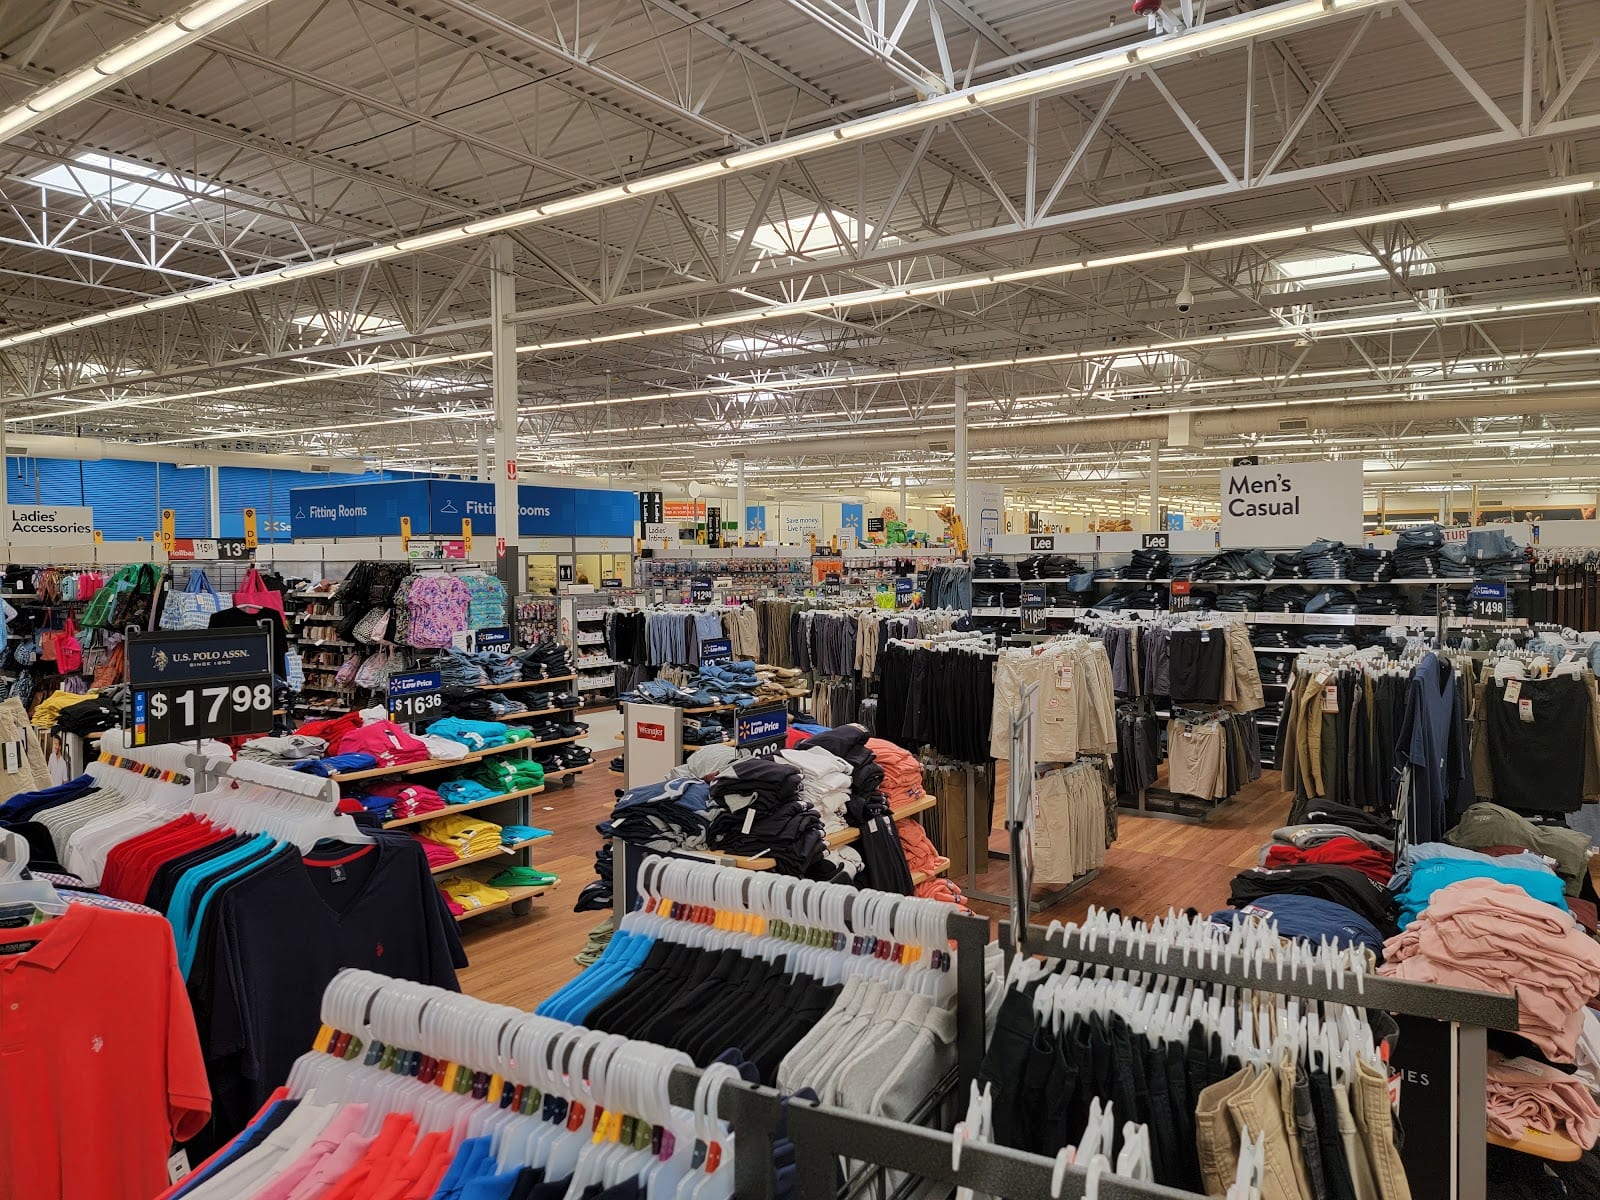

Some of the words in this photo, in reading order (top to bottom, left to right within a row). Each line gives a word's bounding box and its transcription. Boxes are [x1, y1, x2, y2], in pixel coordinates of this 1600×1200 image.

[1228, 473, 1292, 495] Men's
[309, 505, 337, 521] Fitting
[338, 504, 368, 517] Rooms
[517, 503, 551, 517] ooms
[1228, 495, 1300, 517] Casual
[12, 509, 58, 522] Ladies'
[12, 521, 91, 534] Accessories
[1033, 538, 1052, 549] Lee
[1145, 535, 1166, 548] Lee
[217, 542, 248, 557] $139
[172, 653, 192, 662] U.S.
[193, 651, 220, 660] POLO
[221, 649, 251, 659] ASSN.
[402, 681, 417, 689] Low
[416, 679, 433, 688] Price
[638, 726, 664, 738] Wrangler
[750, 724, 764, 736] Low
[764, 721, 780, 732] Price
